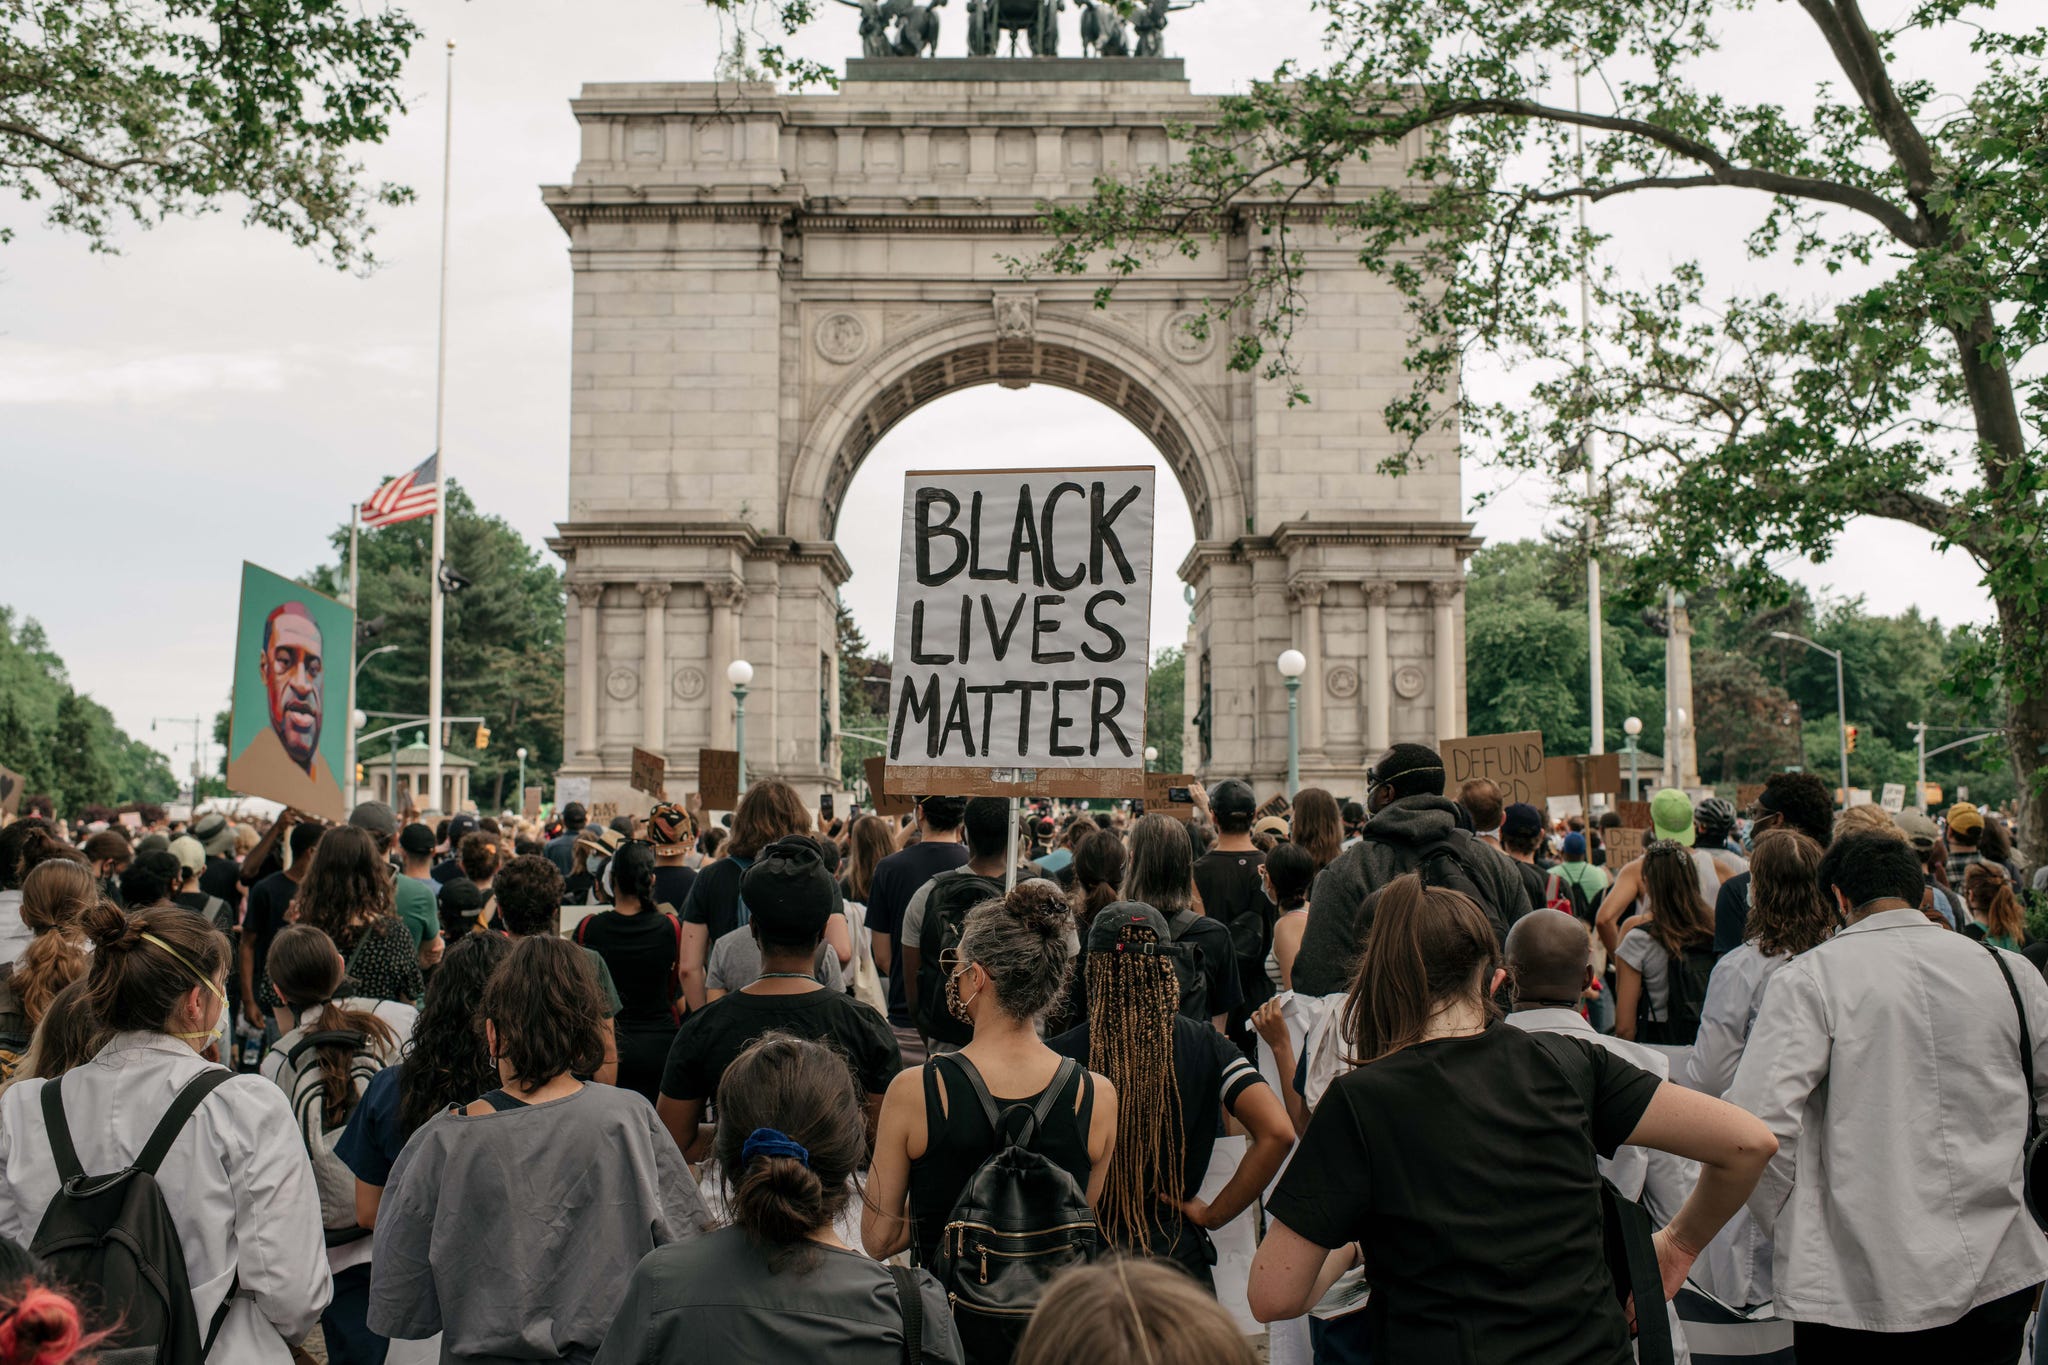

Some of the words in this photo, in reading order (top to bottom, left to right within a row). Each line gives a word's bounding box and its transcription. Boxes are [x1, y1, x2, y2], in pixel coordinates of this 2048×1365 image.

[915, 482, 1141, 591] BLACK
[911, 590, 1126, 665] LIVES
[890, 673, 1133, 760] MATTER
[1453, 744, 1542, 782] DEFUND
[1610, 830, 1640, 846] DEF
